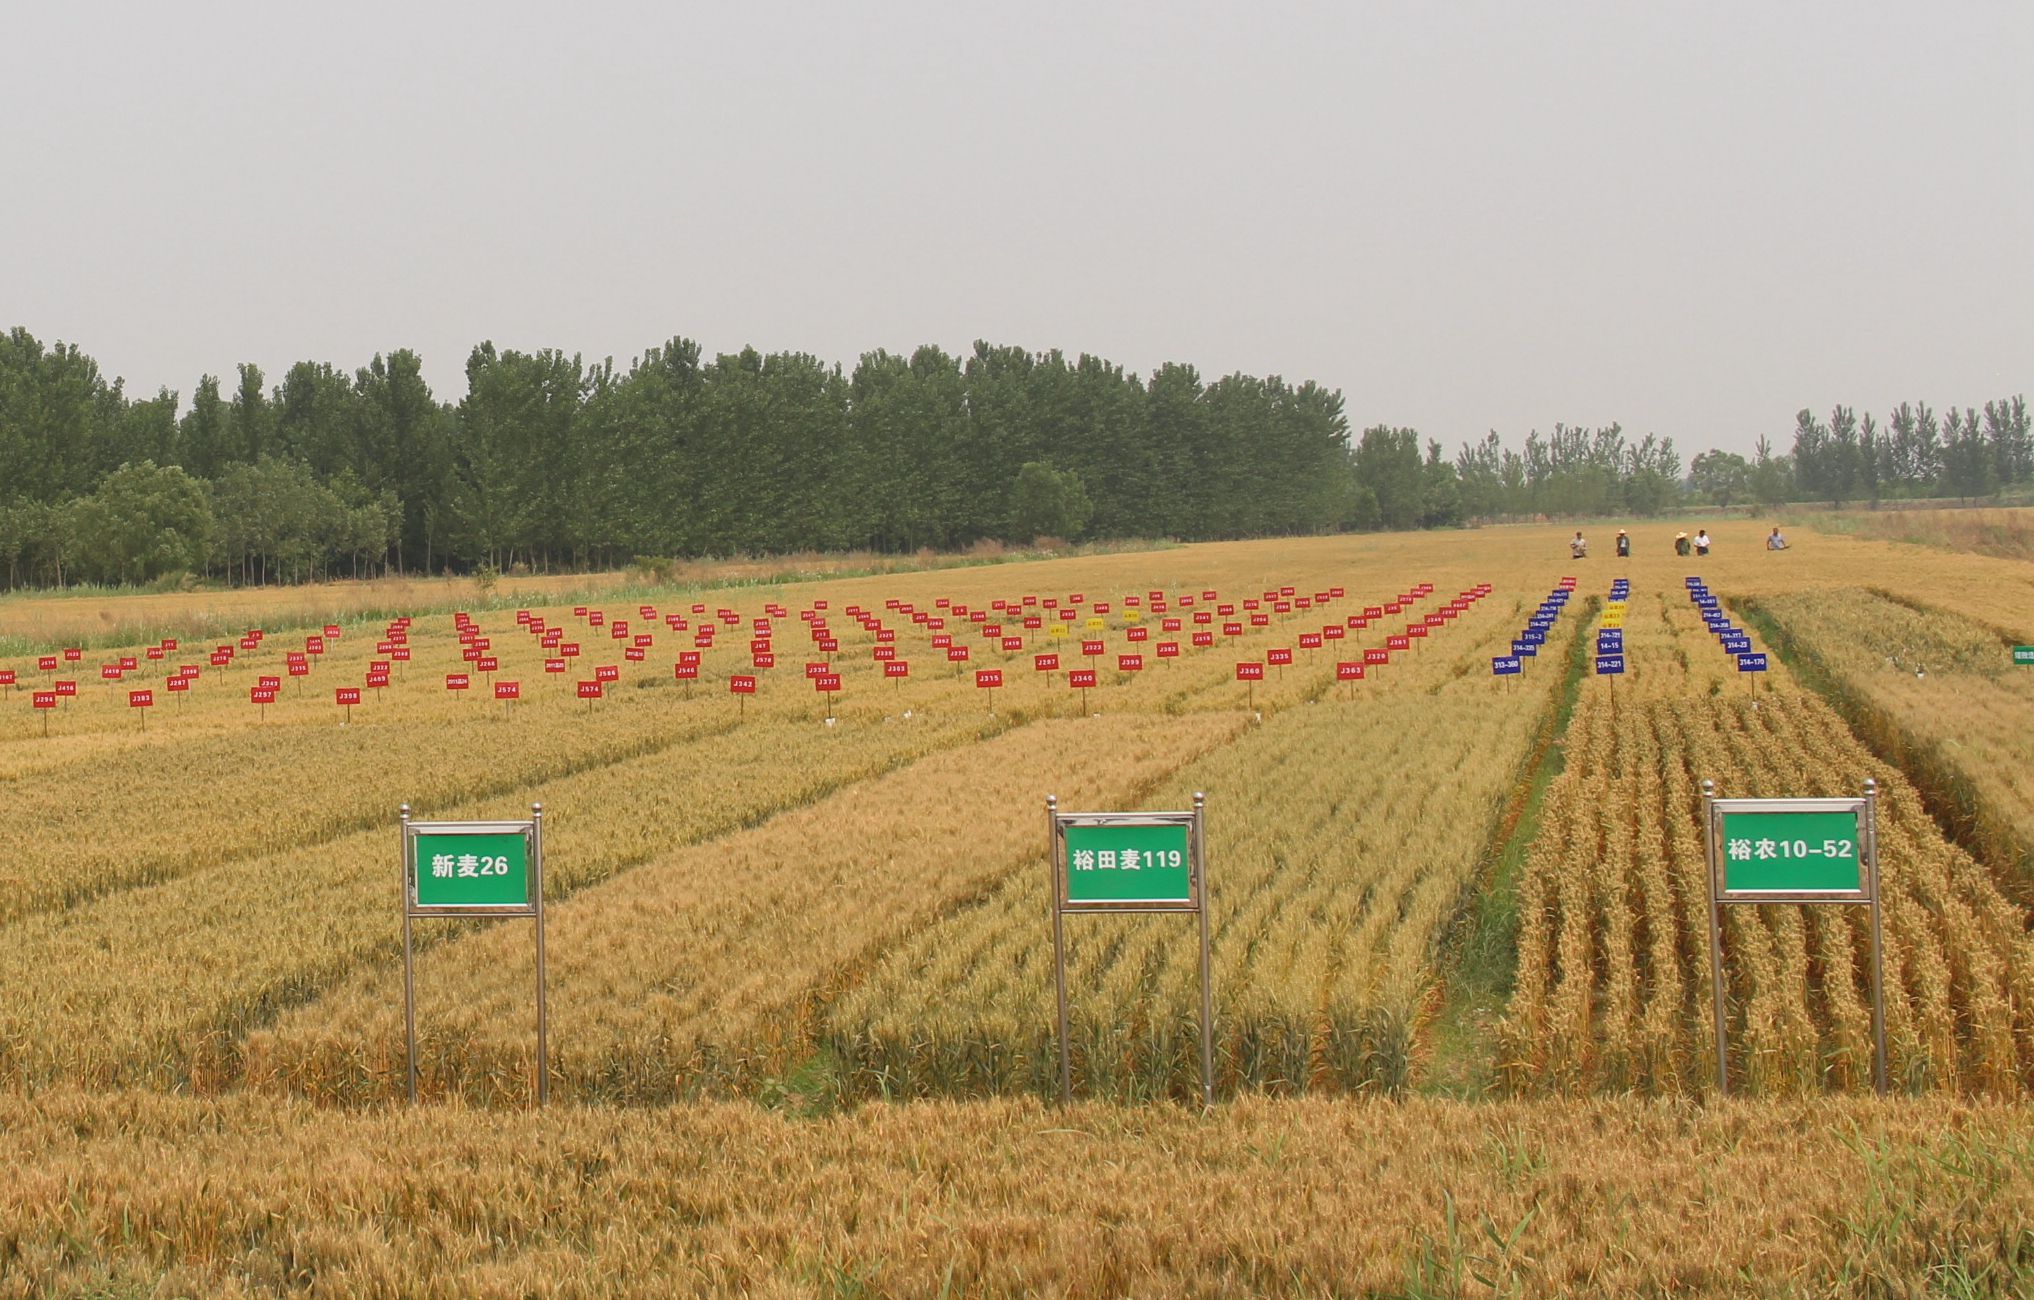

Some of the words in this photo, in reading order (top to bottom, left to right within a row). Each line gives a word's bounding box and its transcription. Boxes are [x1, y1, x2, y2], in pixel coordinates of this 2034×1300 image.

[432, 854, 508, 878] 新麦26
[1073, 849, 1181, 870] 裕田麦119
